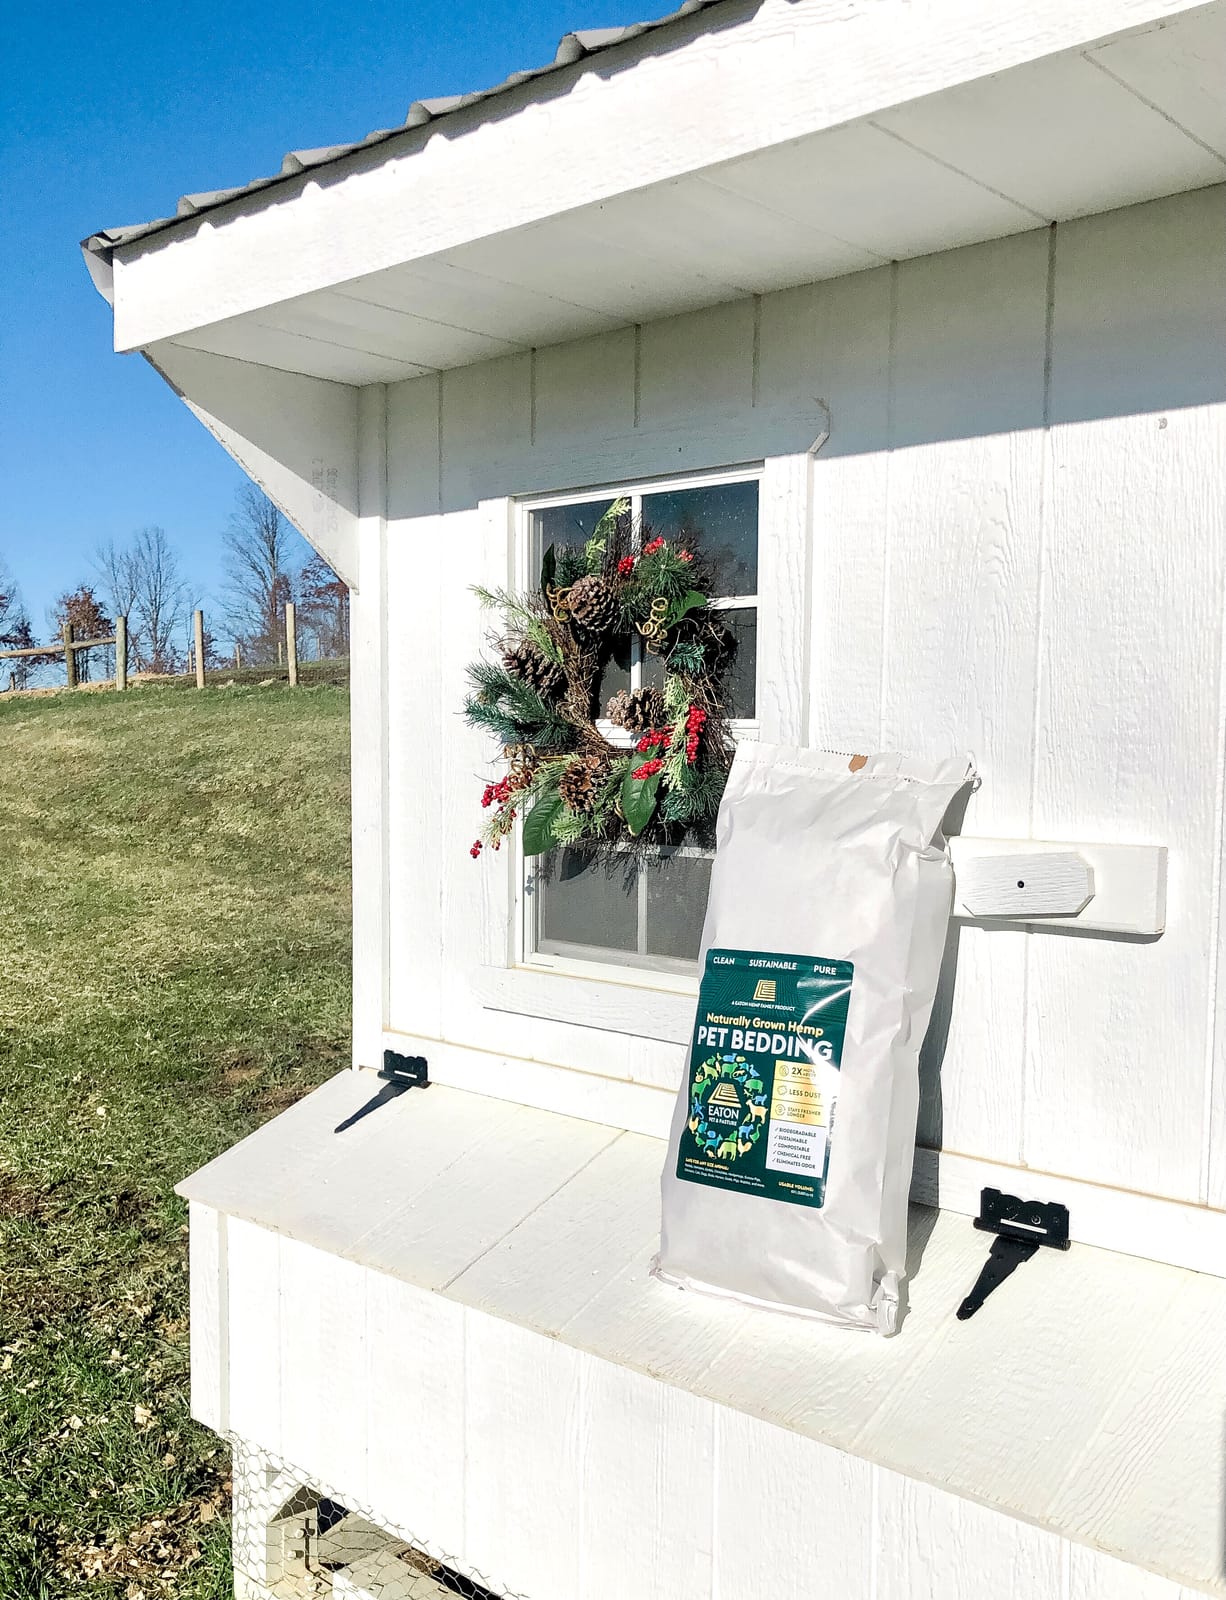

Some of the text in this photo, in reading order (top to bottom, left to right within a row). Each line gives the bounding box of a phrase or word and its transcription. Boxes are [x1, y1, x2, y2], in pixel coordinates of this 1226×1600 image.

[713, 956, 735, 965] CLEAN
[749, 959, 797, 970] SUSTAINABLE
[813, 965, 837, 975] PURE
[707, 1013, 824, 1038] Naturally Grown Hemp
[697, 1026, 833, 1061] PET BEDDING
[792, 1067, 803, 1076] 2X
[804, 1091, 821, 1099] DUST
[708, 1105, 739, 1119] EATON
[779, 1127, 816, 1138] BIODEGRADABLE
[778, 1135, 808, 1144] SUSTAINABLE
[777, 1143, 810, 1153] COMPOSTABLE
[776, 1150, 799, 1159] CHEMICAL
[776, 1158, 800, 1167] ELIMINATES
